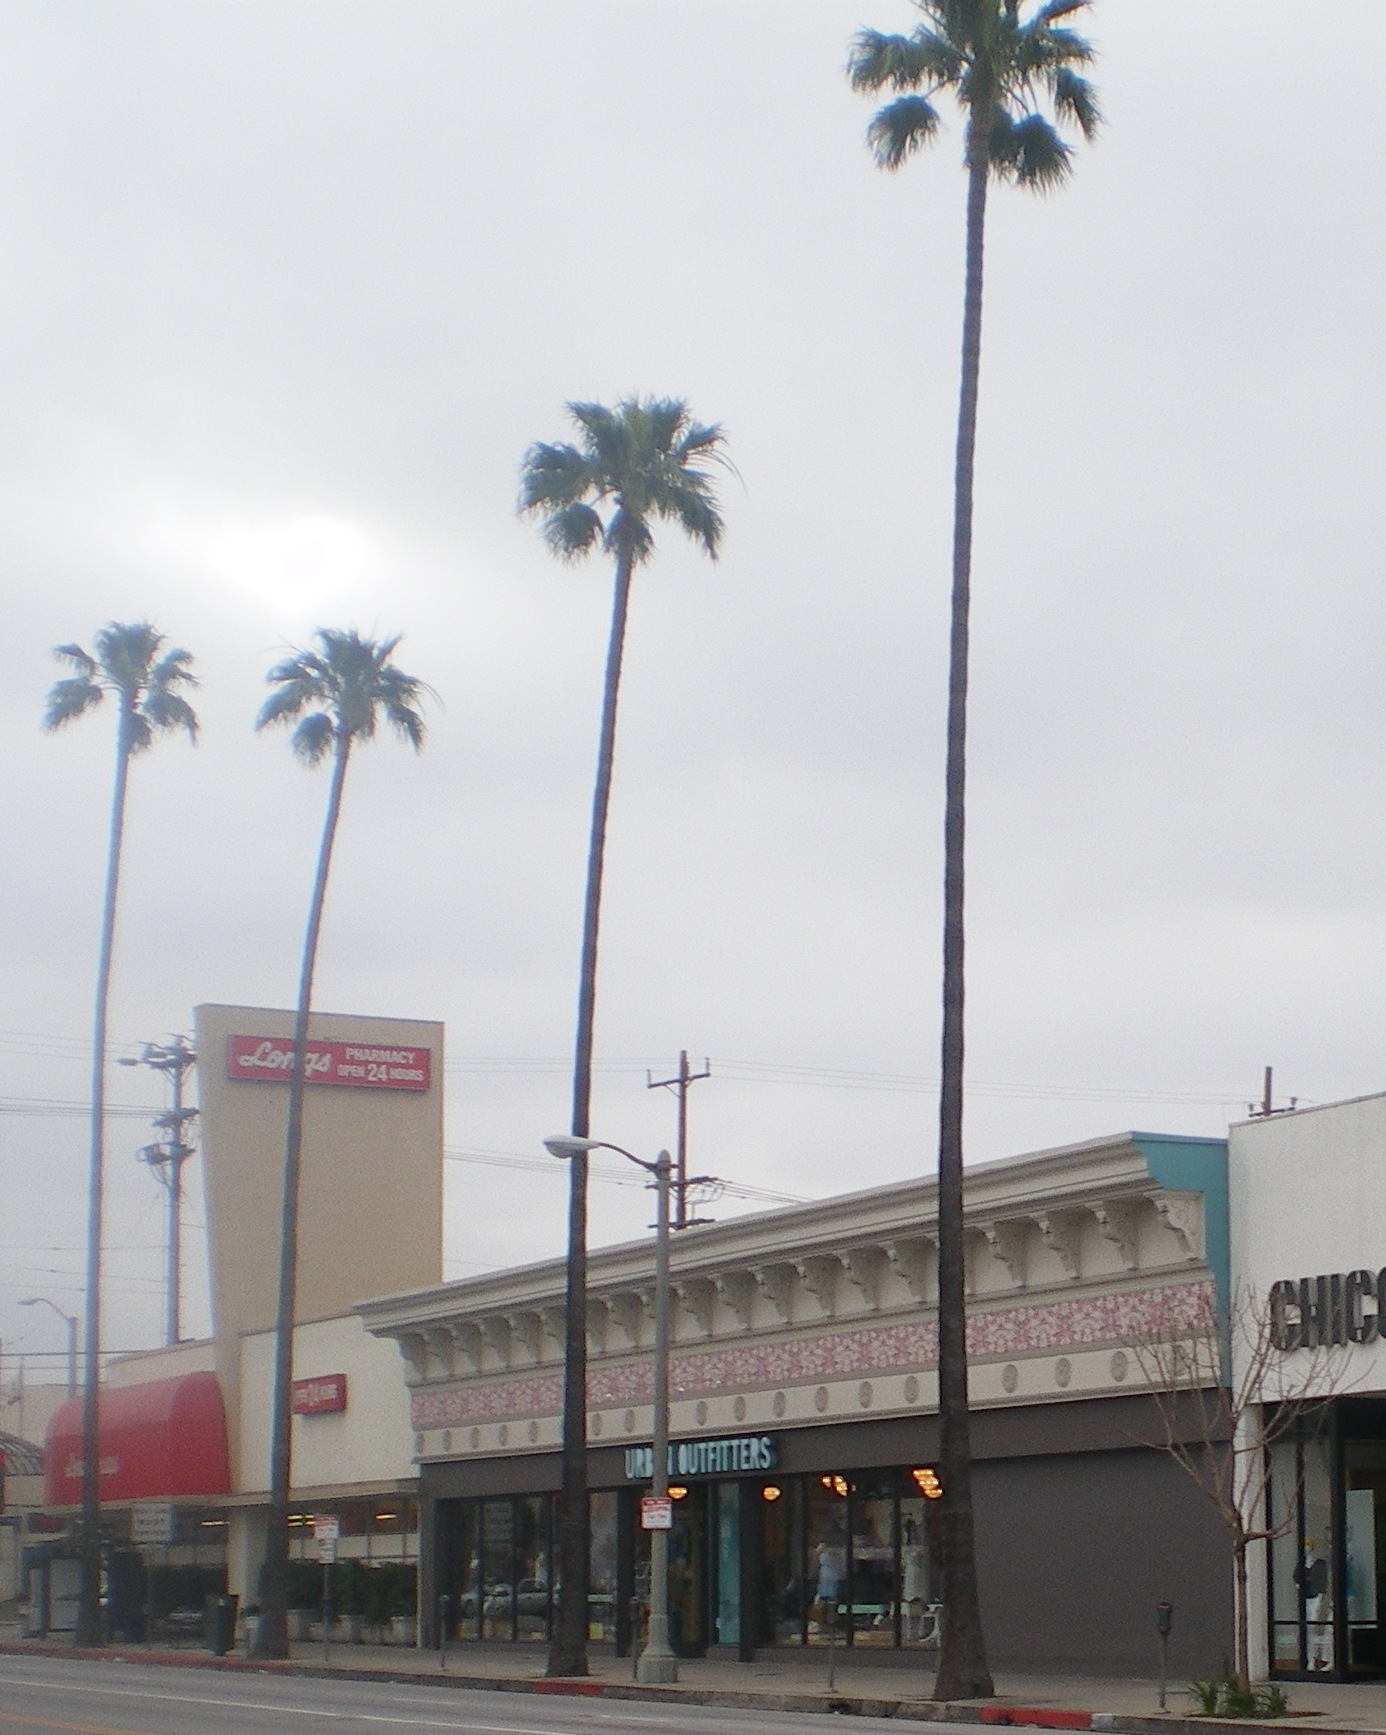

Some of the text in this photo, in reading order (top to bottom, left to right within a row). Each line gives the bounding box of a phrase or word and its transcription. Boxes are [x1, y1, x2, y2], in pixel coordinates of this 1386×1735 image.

[345, 1048, 415, 1064] PHARMACY
[367, 1063, 388, 1082] 24
[679, 1436, 772, 1475] OUTFITTERS
